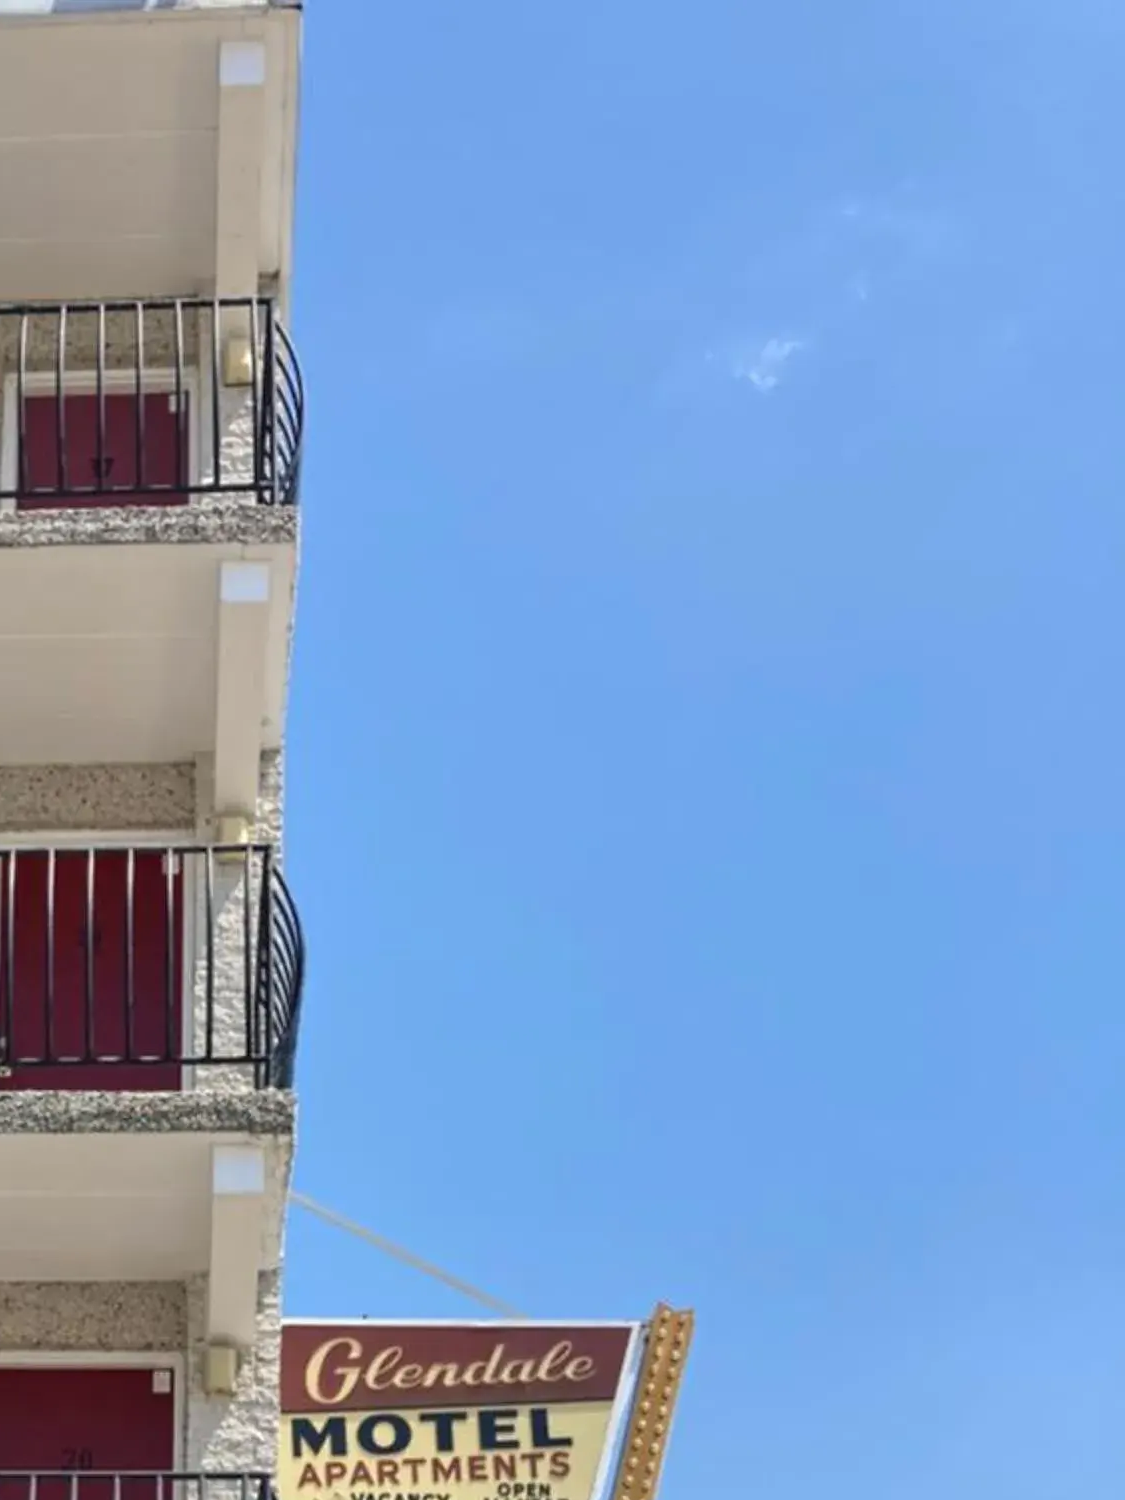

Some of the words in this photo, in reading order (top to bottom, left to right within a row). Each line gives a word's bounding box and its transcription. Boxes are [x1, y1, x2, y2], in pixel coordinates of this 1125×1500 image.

[305, 1337, 595, 1405] Glendale
[291, 1408, 574, 1459] MOTEL
[297, 1451, 572, 1490] APARTMENTS
[497, 1483, 552, 1499] OPEN
